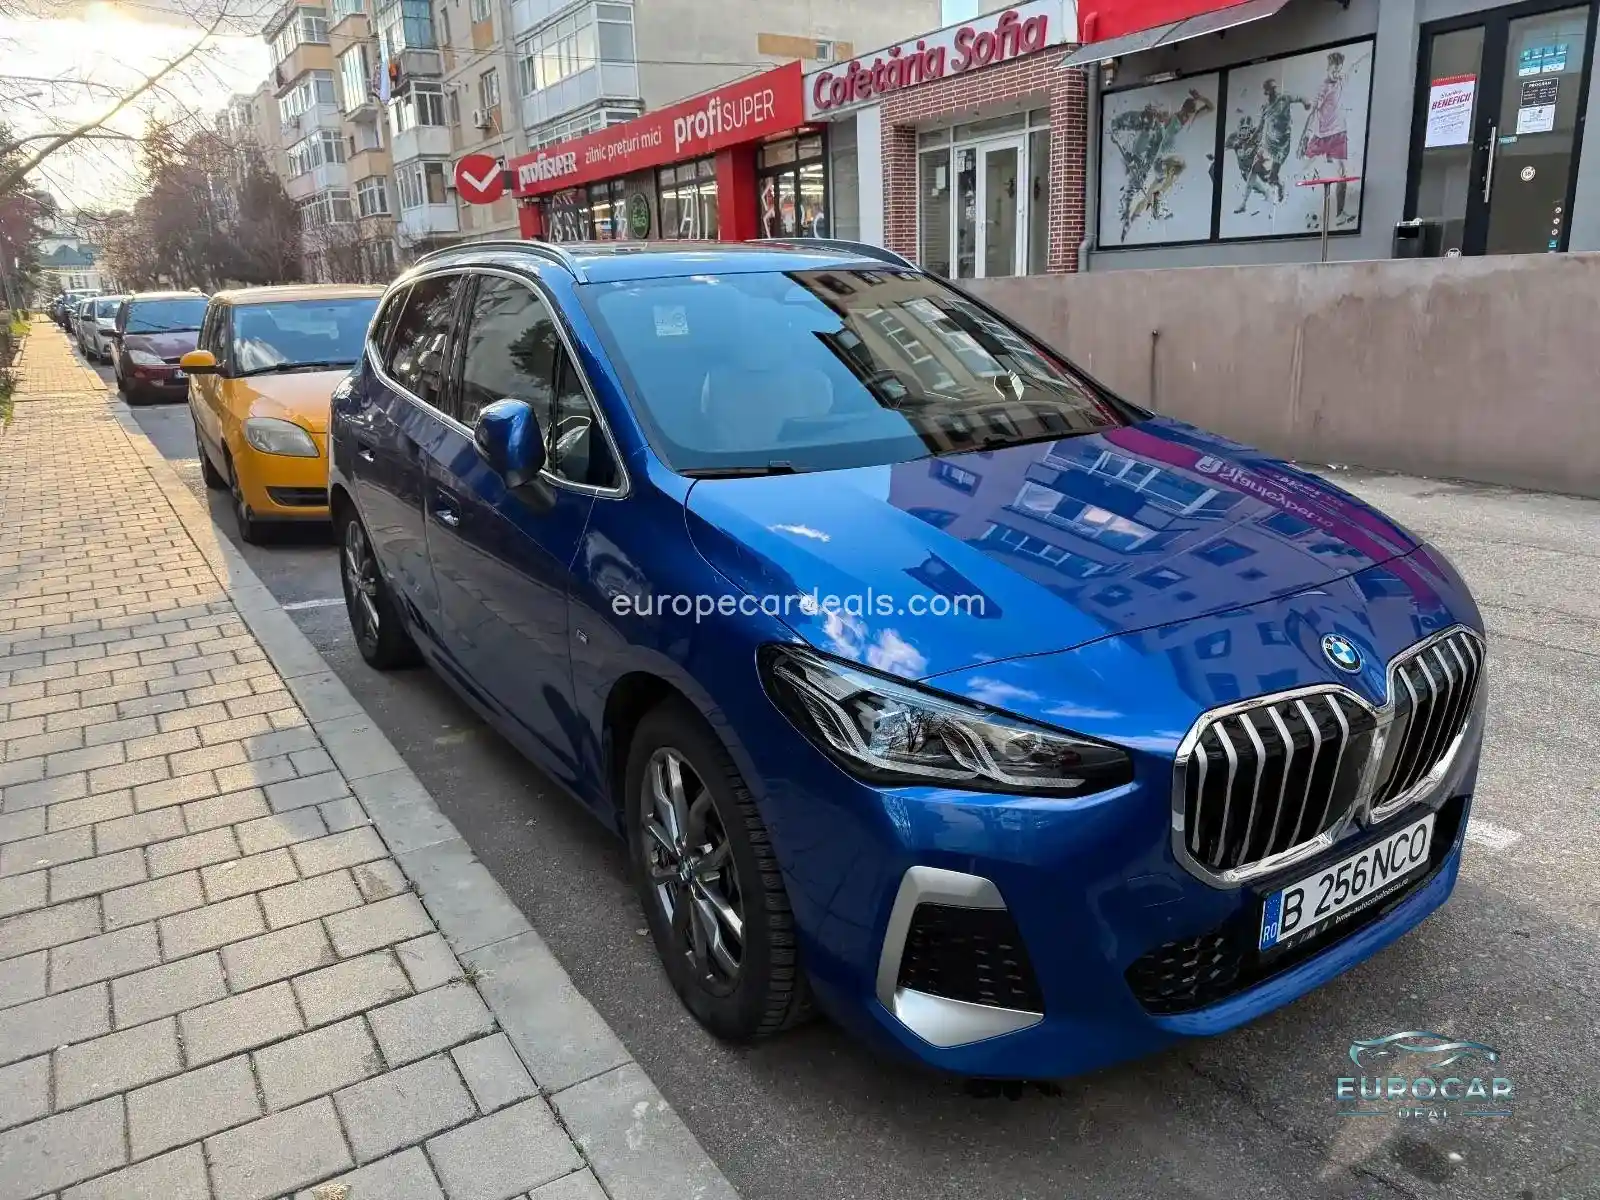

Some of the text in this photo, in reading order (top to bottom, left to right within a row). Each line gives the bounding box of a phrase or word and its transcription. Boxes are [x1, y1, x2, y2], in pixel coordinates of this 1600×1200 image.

[813, 11, 1048, 110] Cofetăria Sofia
[585, 143, 606, 164] zilnic
[641, 125, 662, 148] mici
[674, 88, 775, 153] profiSUPER
[1262, 922, 1277, 943] RO
[1279, 887, 1305, 935] B
